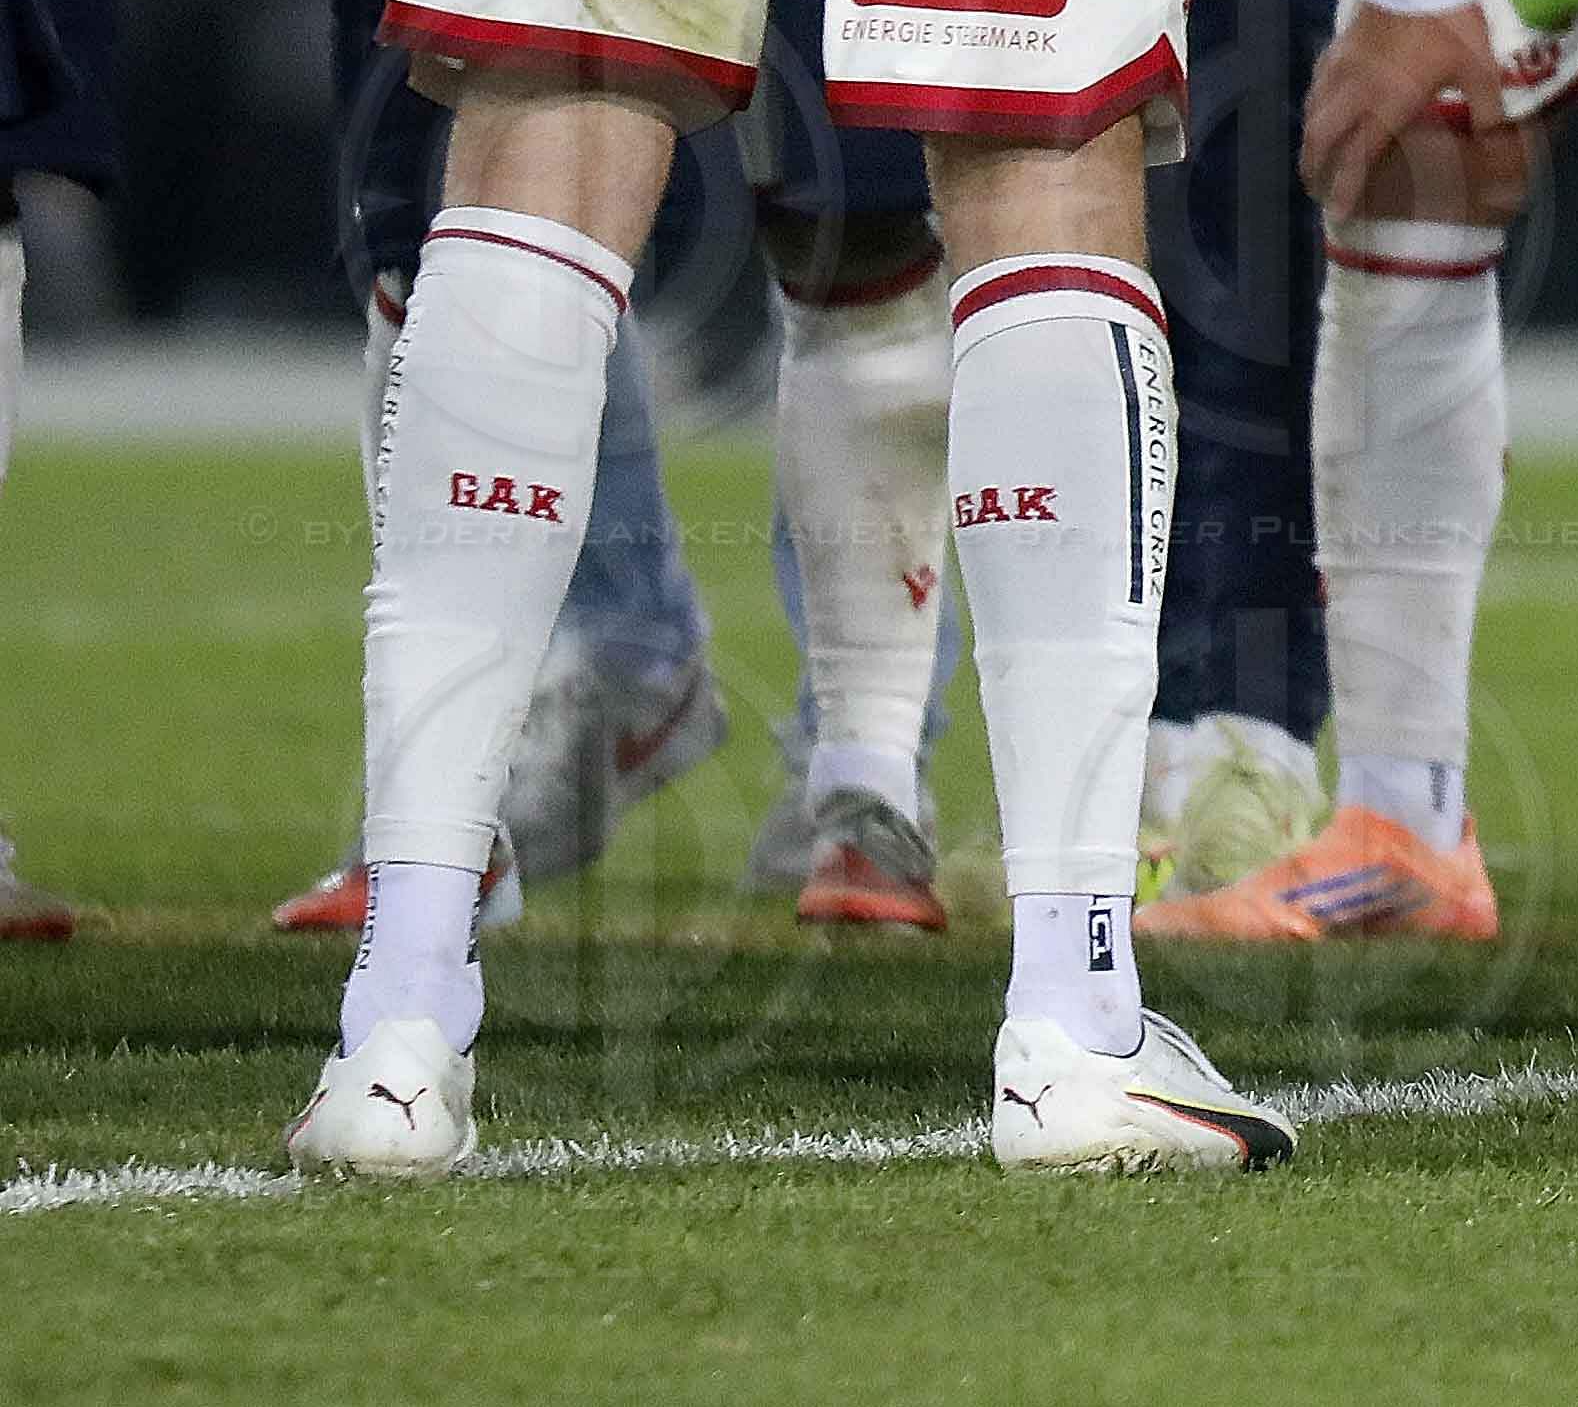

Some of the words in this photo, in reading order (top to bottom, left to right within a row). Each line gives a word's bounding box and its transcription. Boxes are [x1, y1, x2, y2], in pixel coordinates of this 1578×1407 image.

[841, 18, 934, 44] ENERGIE
[941, 25, 1058, 54] STEERMARK
[1138, 339, 1169, 492] ENERGIE
[449, 471, 565, 524] GAK
[955, 485, 1059, 528] GAK
[1149, 509, 1168, 597] GRAZ
